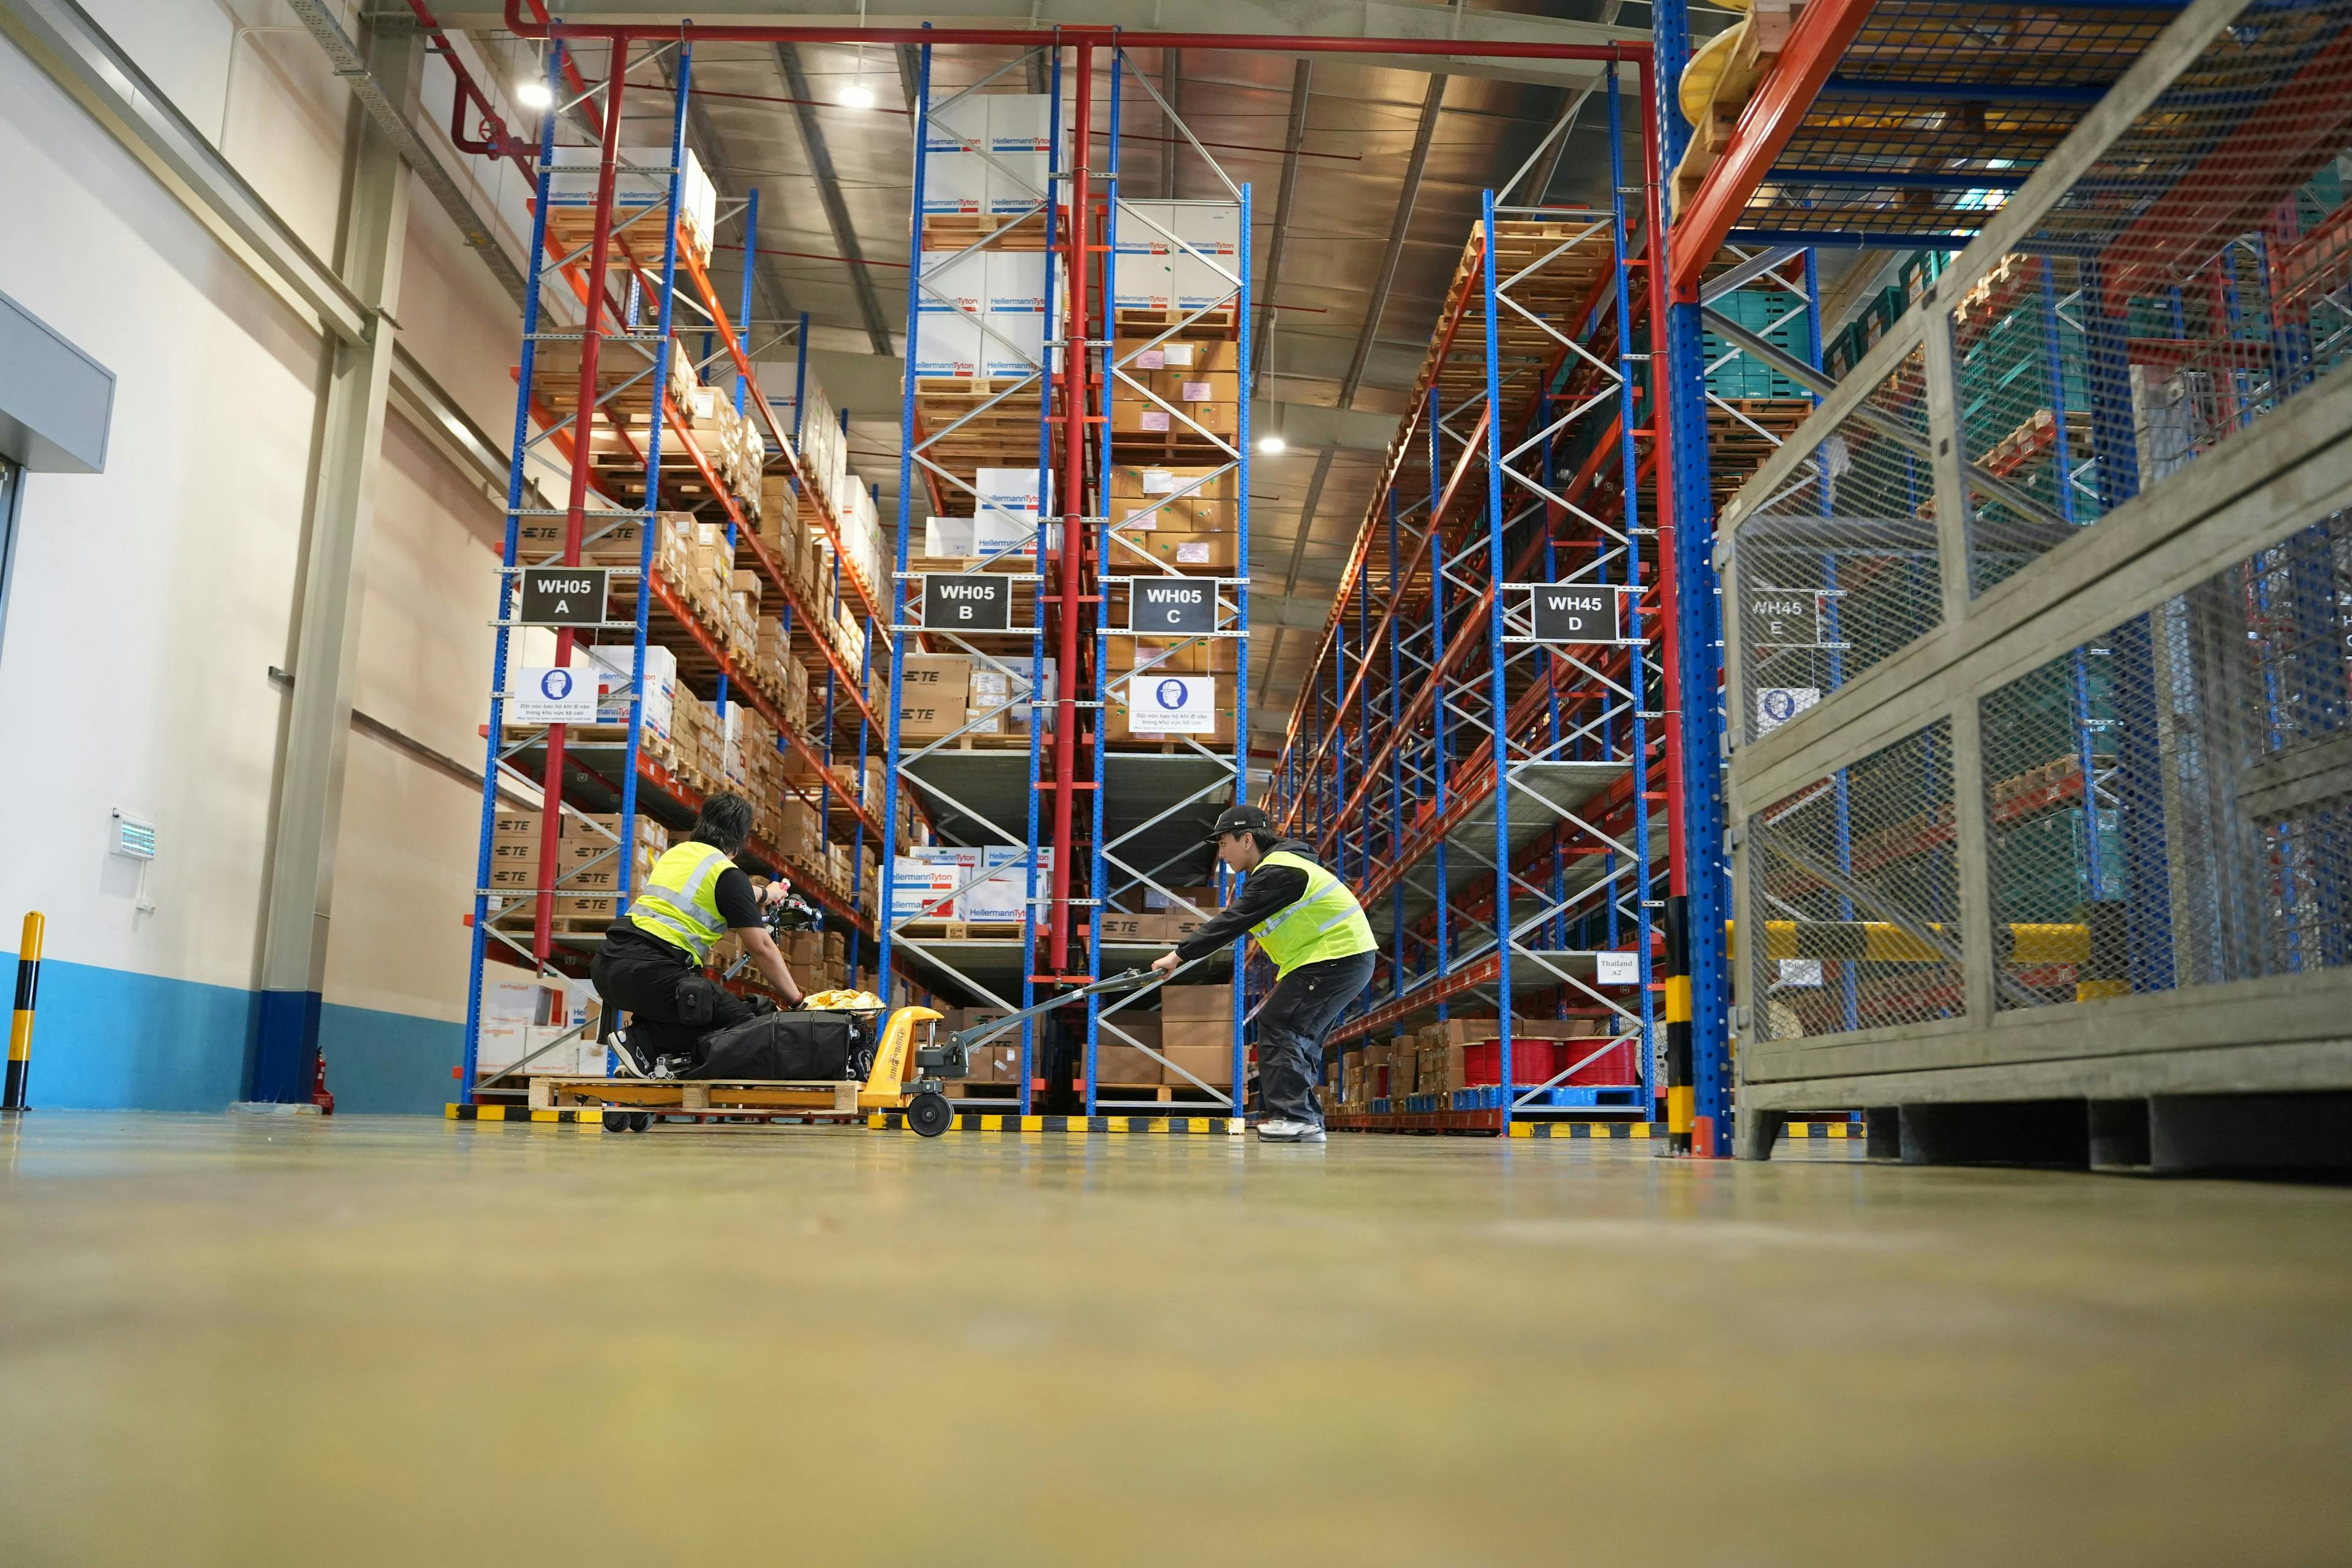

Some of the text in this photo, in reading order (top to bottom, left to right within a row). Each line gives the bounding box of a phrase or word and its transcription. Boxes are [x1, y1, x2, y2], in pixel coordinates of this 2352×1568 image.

[540, 528, 558, 538] TE
[617, 529, 635, 538] TE
[537, 579, 591, 594] WH05
[940, 585, 995, 600] WH05
[1147, 589, 1202, 603] WH05
[554, 600, 570, 613] A
[1548, 597, 1602, 611] WH45
[959, 606, 973, 619] B
[1167, 609, 1181, 624] C
[1569, 617, 1582, 630] D
[1770, 621, 1784, 635] E
[921, 672, 939, 682] TE
[918, 709, 935, 719] TE
[514, 821, 530, 830] TE
[513, 846, 529, 856] TE
[511, 872, 527, 881] TE
[593, 873, 610, 883] TE
[892, 873, 952, 883] ellermannTyton
[592, 899, 608, 909] TE
[970, 909, 1027, 918] HellermannTyt
[1121, 921, 1139, 932] TE
